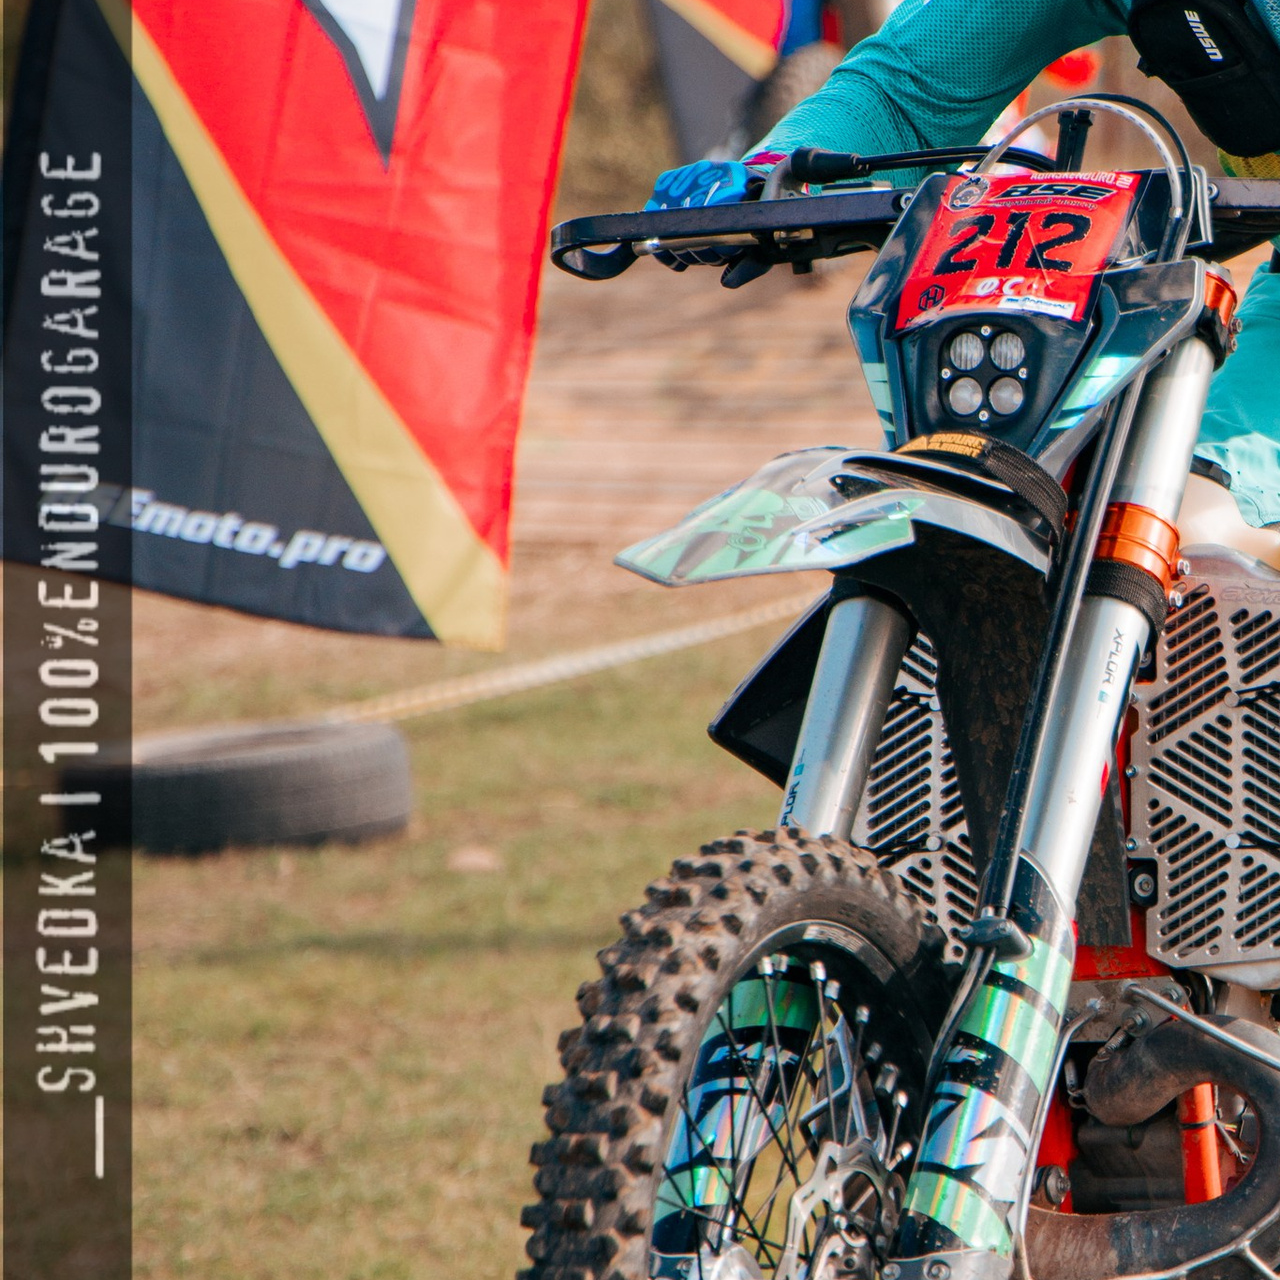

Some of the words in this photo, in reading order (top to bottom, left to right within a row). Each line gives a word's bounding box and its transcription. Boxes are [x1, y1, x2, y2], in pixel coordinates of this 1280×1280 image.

[1184, 10, 1223, 60] USWE
[992, 183, 1118, 201] BSE
[933, 211, 1093, 276] 212
[781, 781, 800, 826] PLOR
